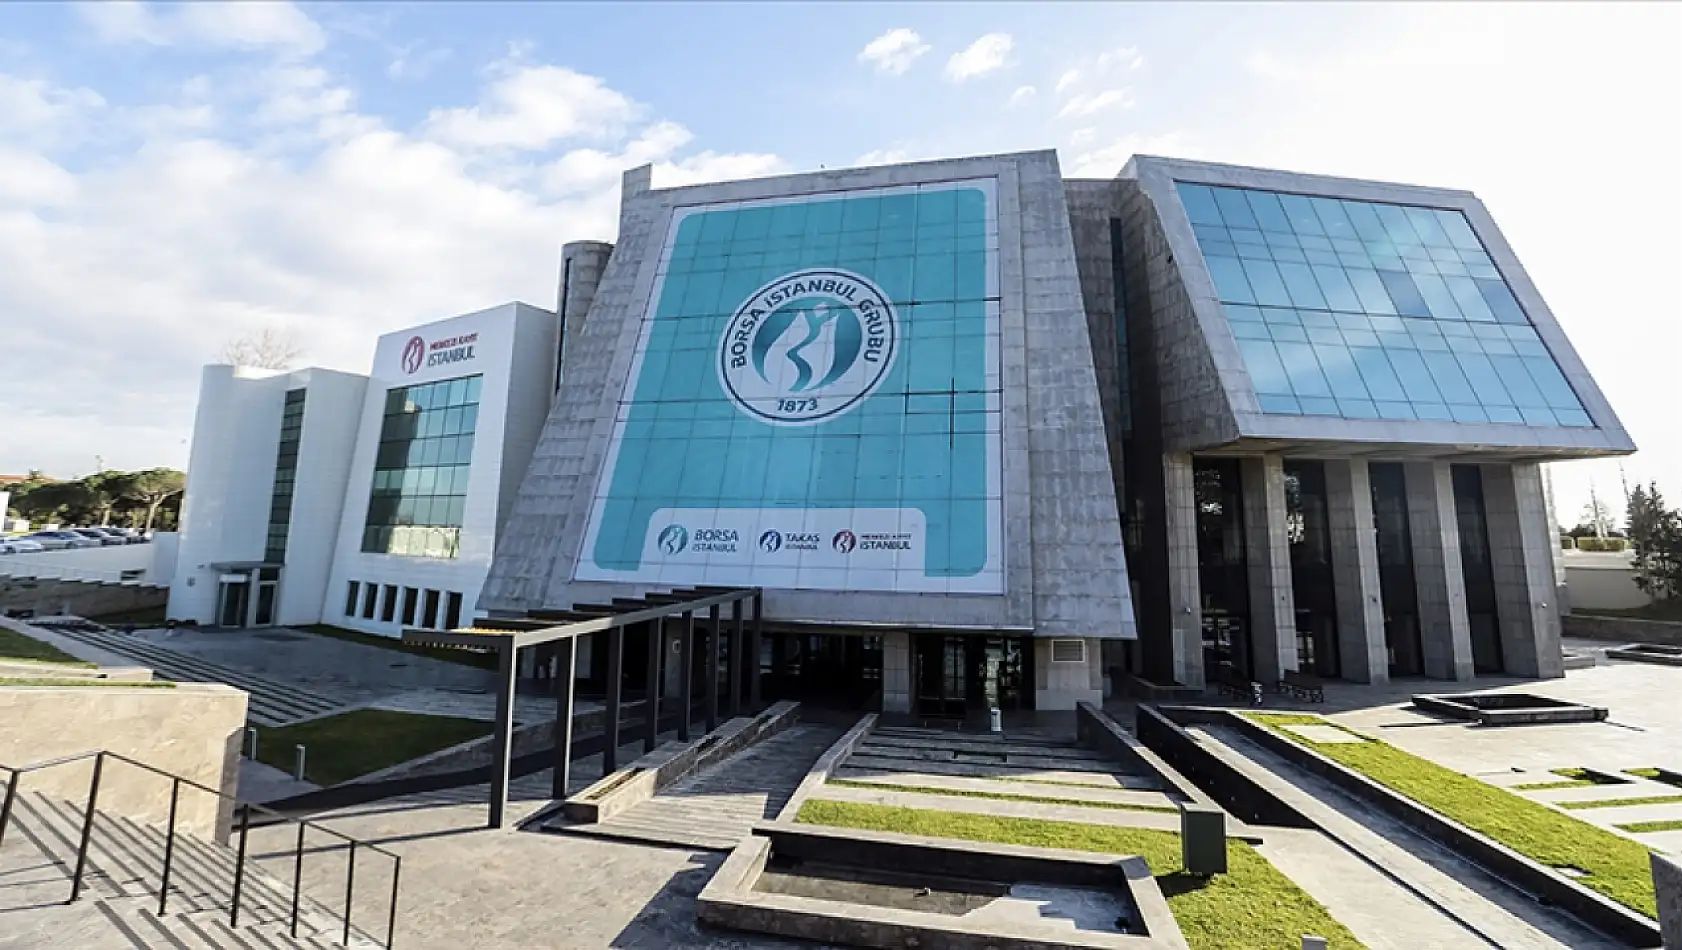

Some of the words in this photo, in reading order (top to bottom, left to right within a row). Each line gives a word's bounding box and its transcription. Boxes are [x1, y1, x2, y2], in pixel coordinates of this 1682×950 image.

[731, 308, 765, 369] BORSA
[859, 299, 884, 363] GRUBU
[777, 397, 818, 412] 1873
[694, 528, 739, 541] BORSA
